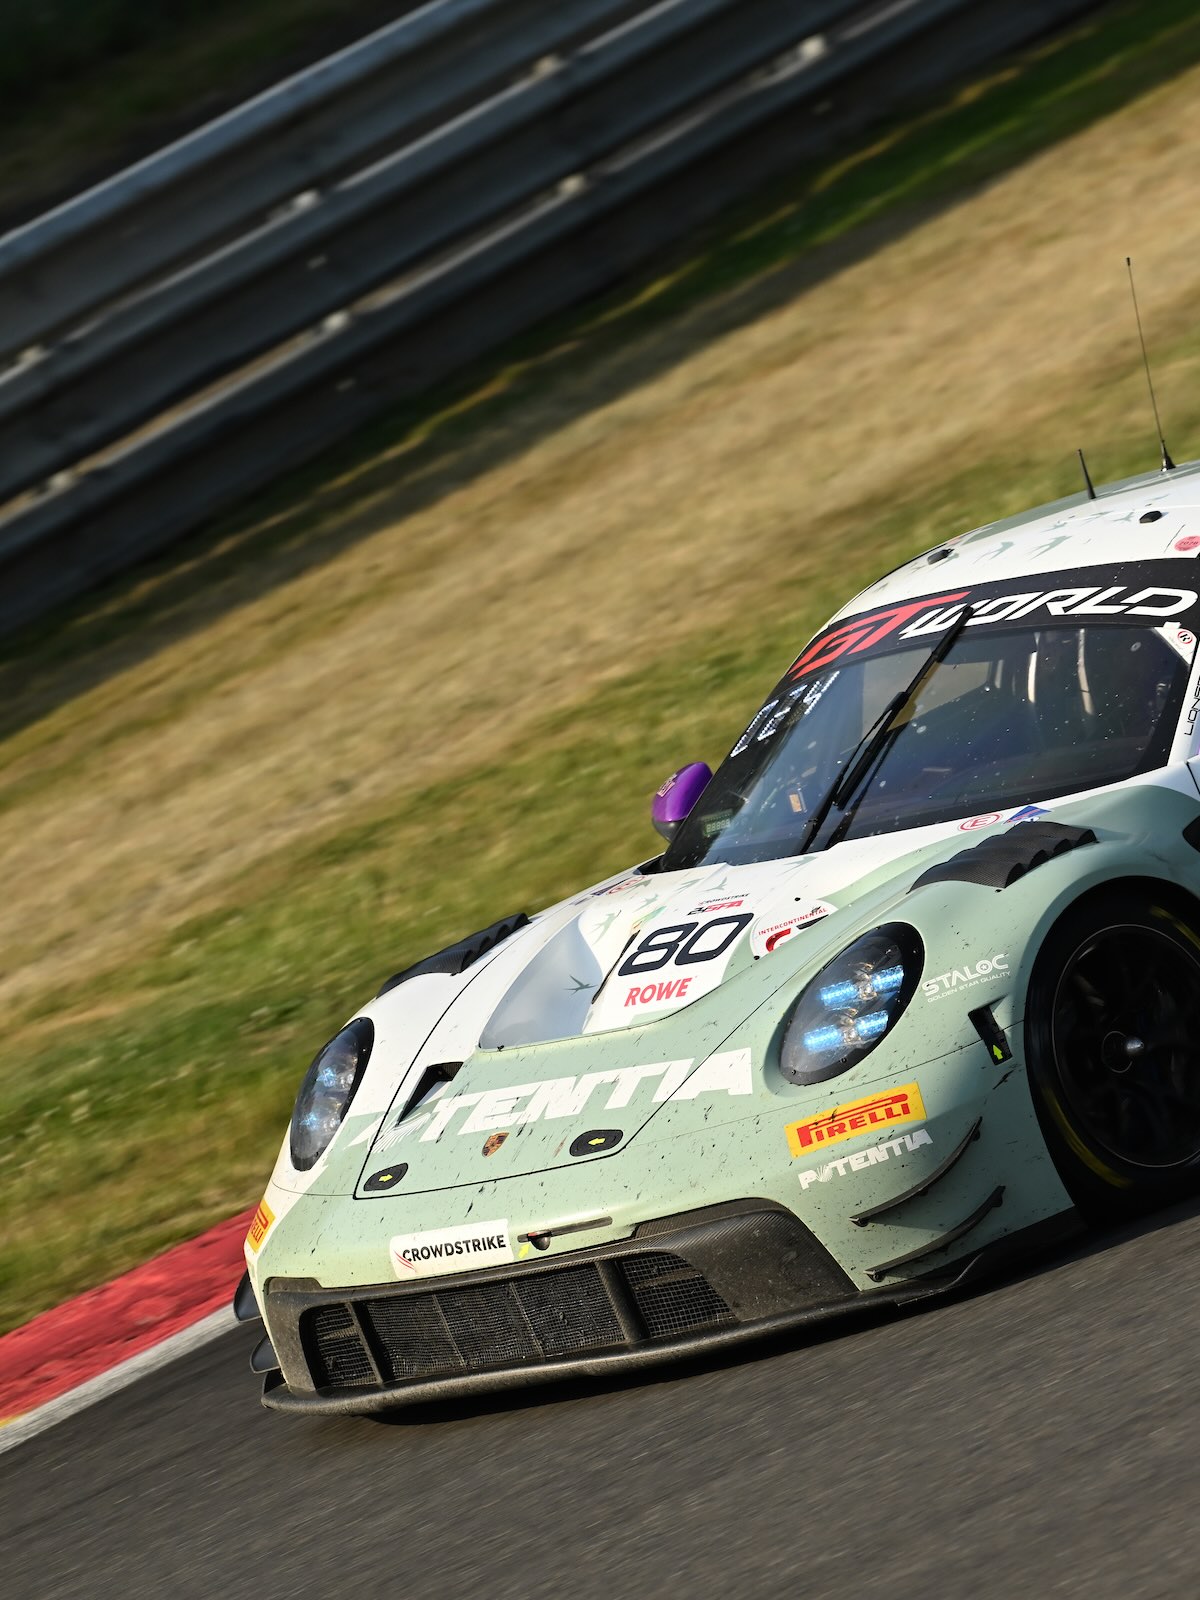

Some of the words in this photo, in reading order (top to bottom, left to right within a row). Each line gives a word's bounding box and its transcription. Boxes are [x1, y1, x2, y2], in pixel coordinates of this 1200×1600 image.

[788, 591, 972, 681] GT
[899, 586, 1198, 641] WORLD
[758, 908, 828, 936] INTERCONTINENTAL
[618, 913, 754, 976] 80
[624, 978, 692, 1008] ROWE
[922, 953, 1010, 997] STALOC
[927, 988, 958, 1003] GOLDEN
[959, 980, 979, 992] STAR
[980, 970, 1011, 984] QUALITY
[796, 1093, 911, 1149] PIRELLI
[402, 1234, 507, 1264] CROWDSTRIKE
